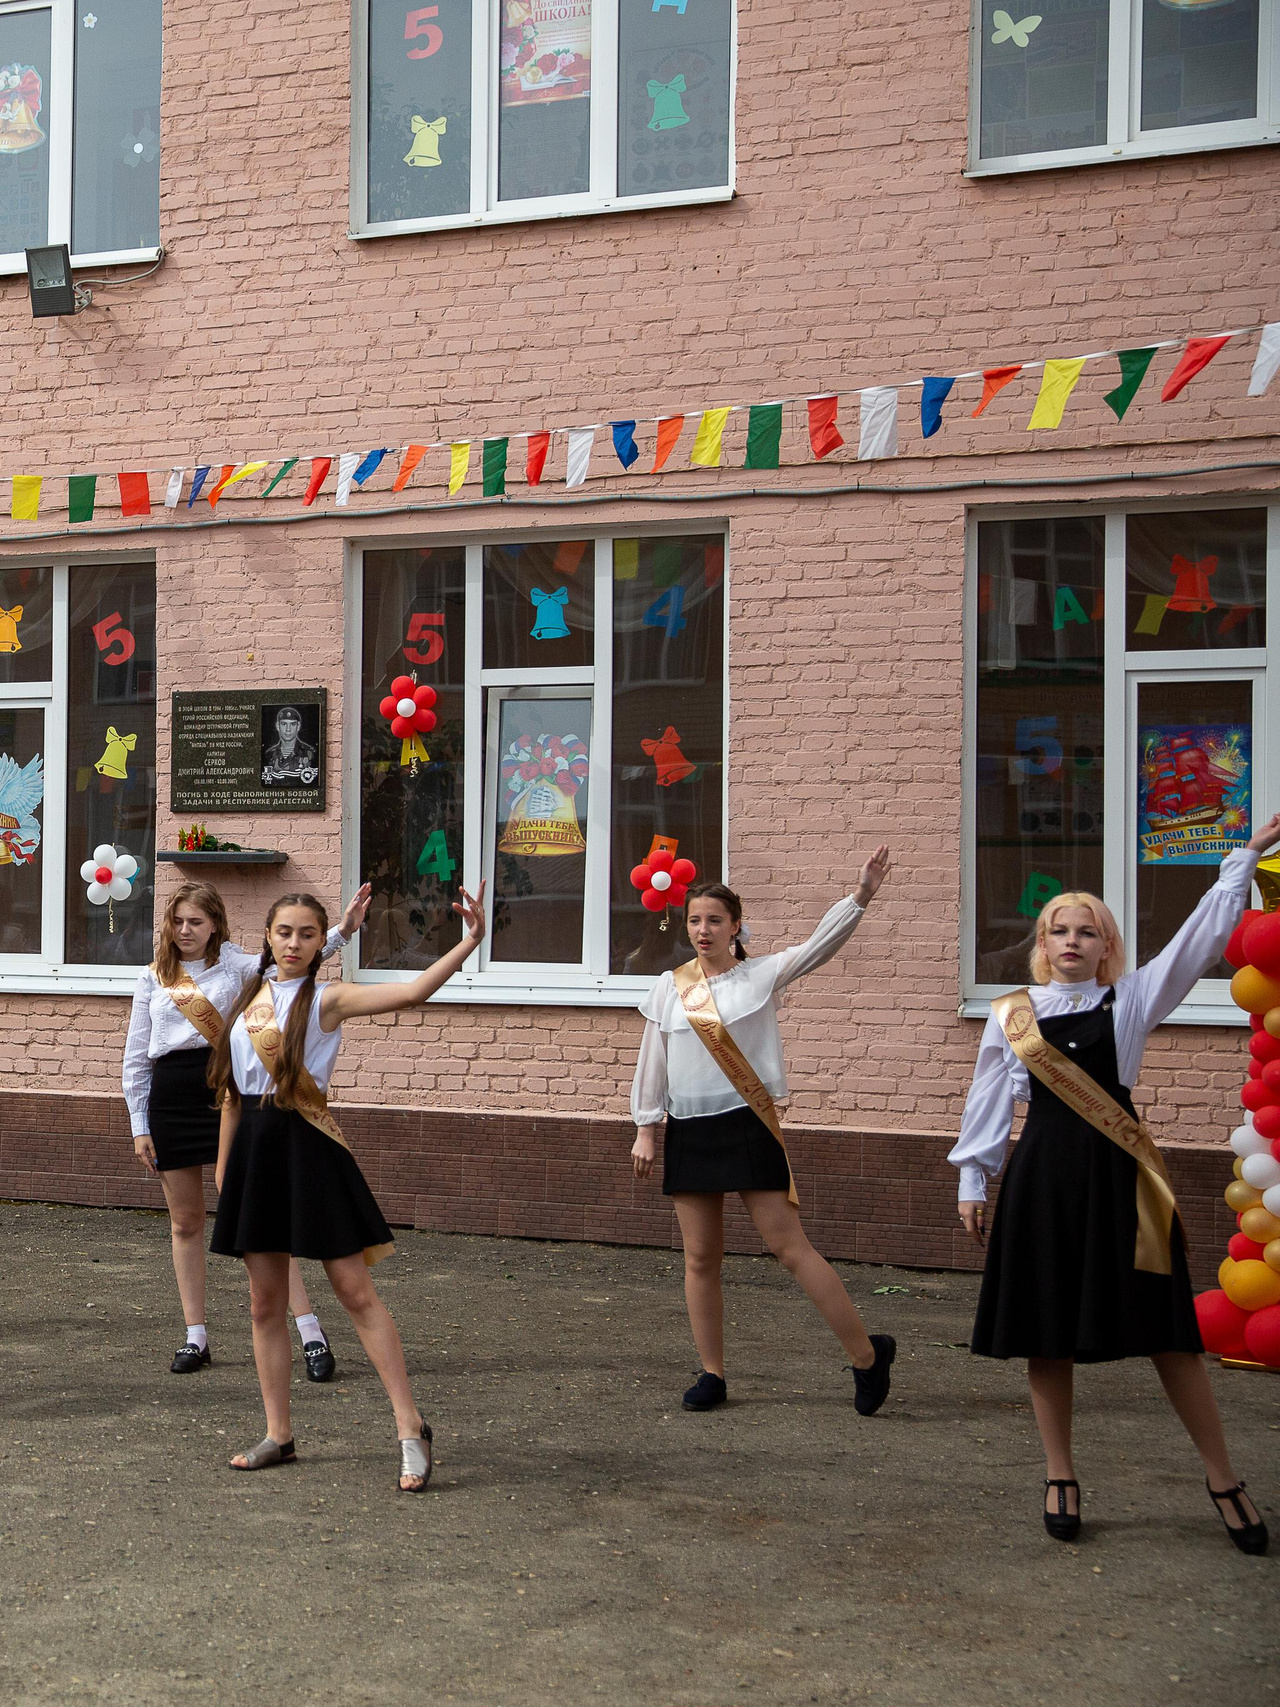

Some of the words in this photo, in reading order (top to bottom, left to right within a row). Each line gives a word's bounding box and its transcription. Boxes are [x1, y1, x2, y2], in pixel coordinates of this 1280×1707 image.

[403, 5, 444, 60] 5
[535, 4, 590, 22] ШКОЛА!
[642, 584, 688, 638] 4
[1052, 586, 1090, 632] А
[92, 610, 136, 666] 5
[402, 612, 446, 666] 5
[1014, 715, 1064, 776] 5
[416, 828, 456, 882] 4
[1144, 830, 1184, 845] УДАЧИ
[1187, 826, 1221, 838] ТЕБЕ,
[1168, 841, 1246, 855] ВЫПУСКНИК!
[742, 1079, 774, 1112] 2021
[1022, 1034, 1106, 1114] Выпускница
[1100, 1107, 1145, 1148] 2021
